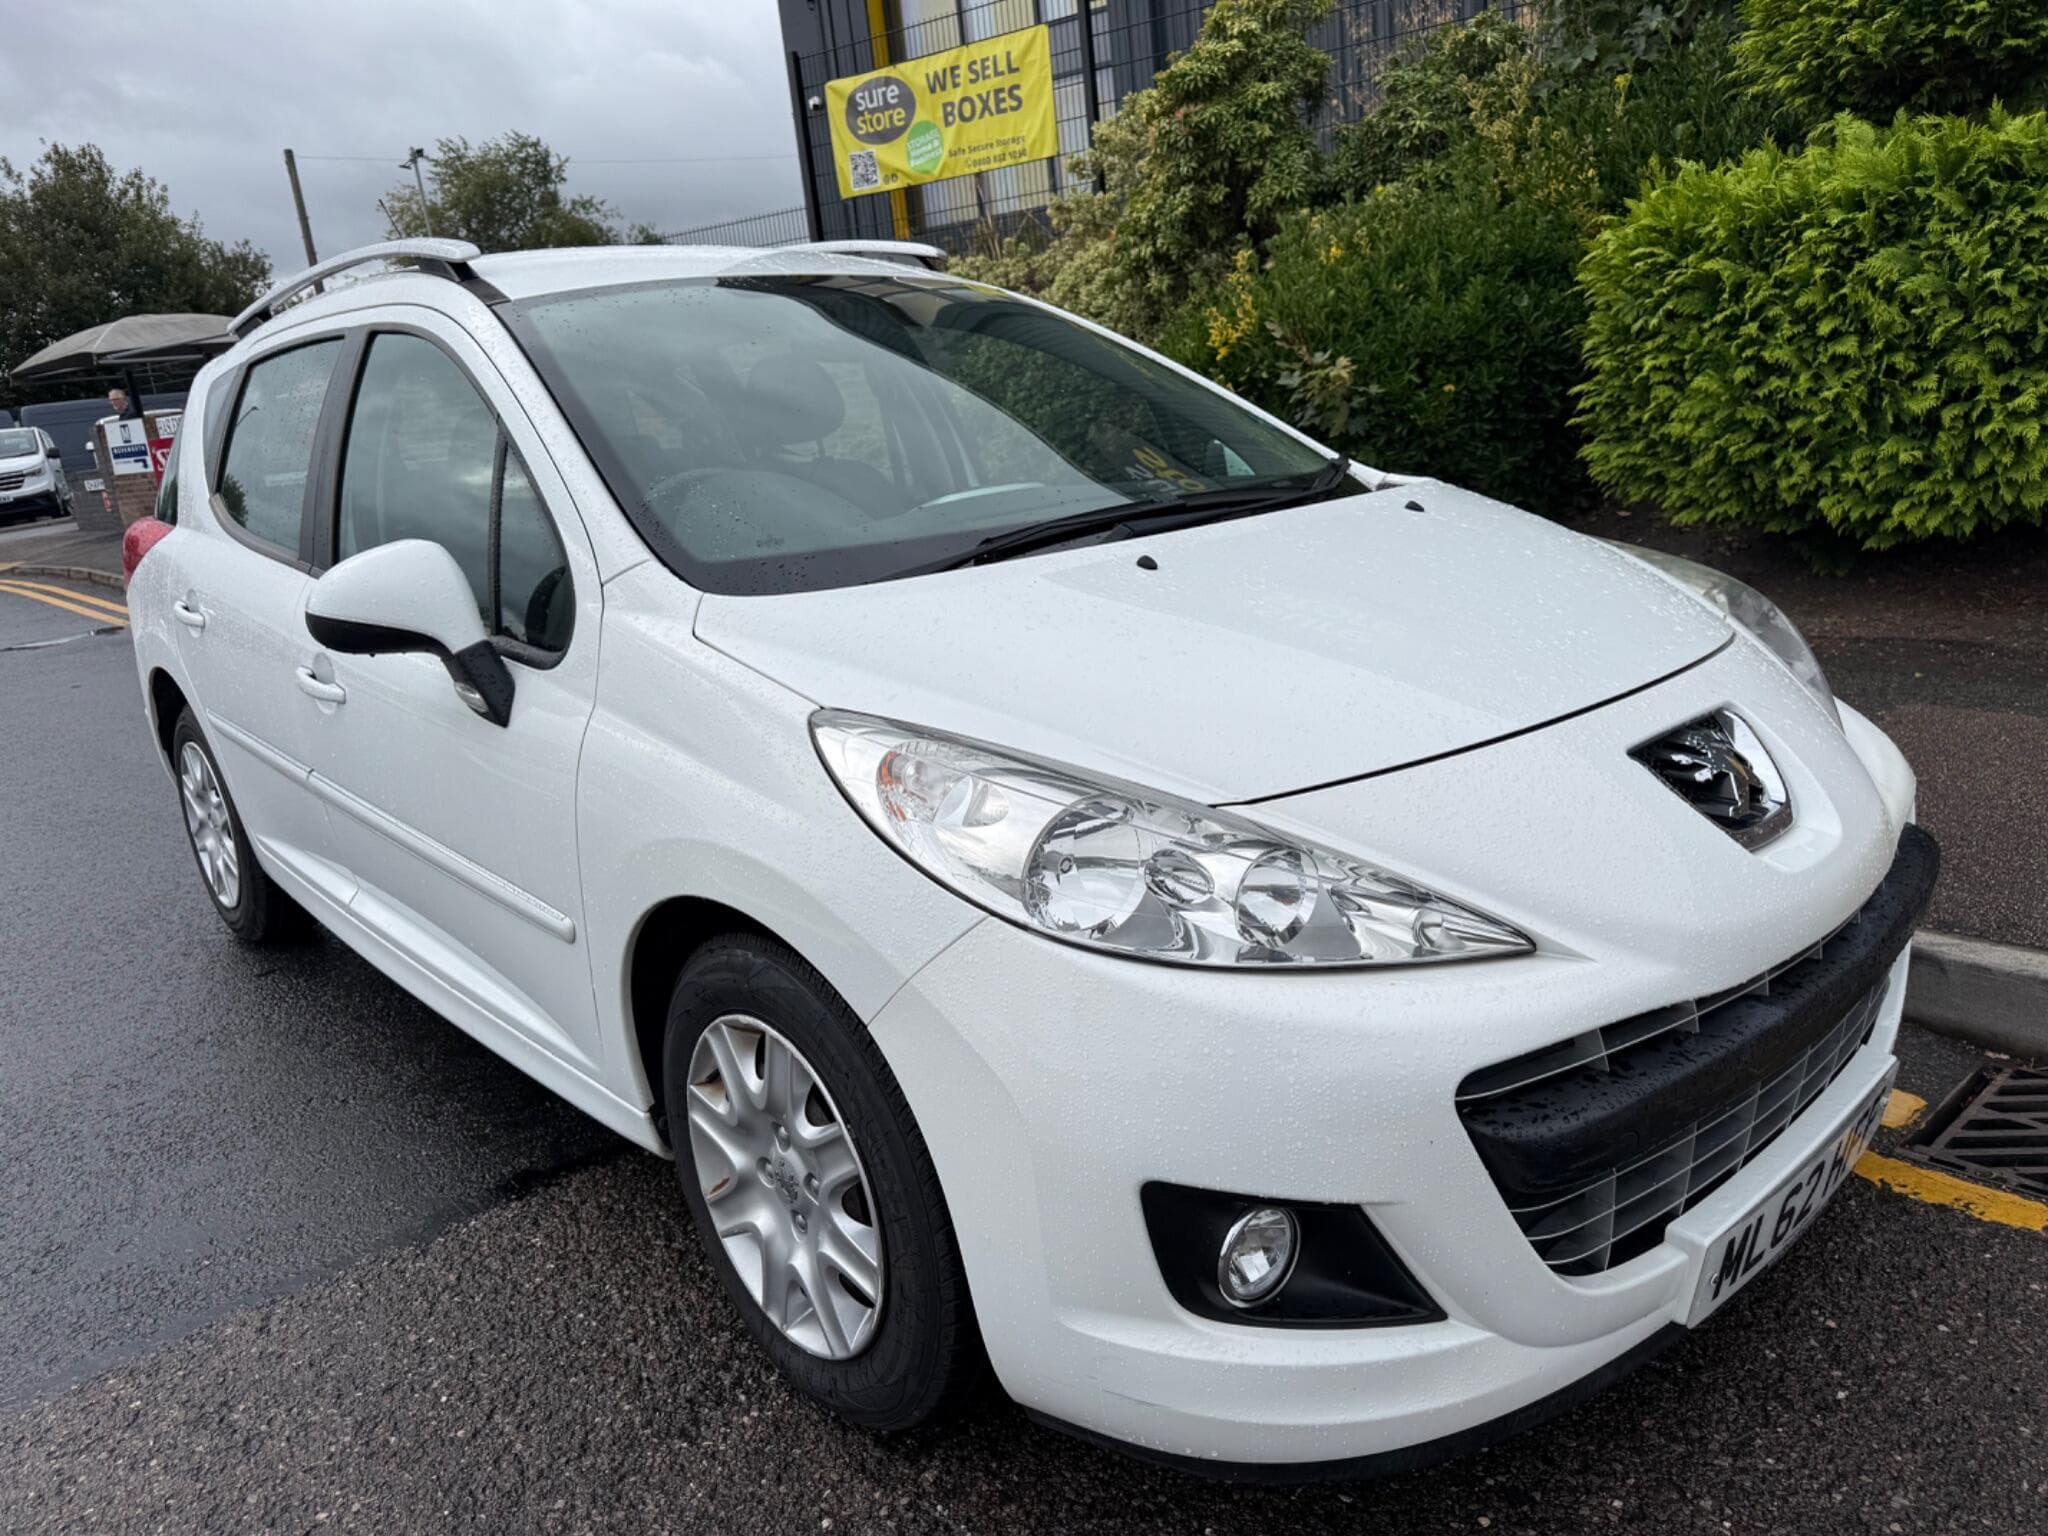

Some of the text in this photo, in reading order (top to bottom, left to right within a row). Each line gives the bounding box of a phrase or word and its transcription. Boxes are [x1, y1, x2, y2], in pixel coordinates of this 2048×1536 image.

[925, 50, 1020, 95] WE SELL
[855, 84, 900, 111] sure
[942, 83, 1023, 128] BOXES
[857, 107, 906, 135] store
